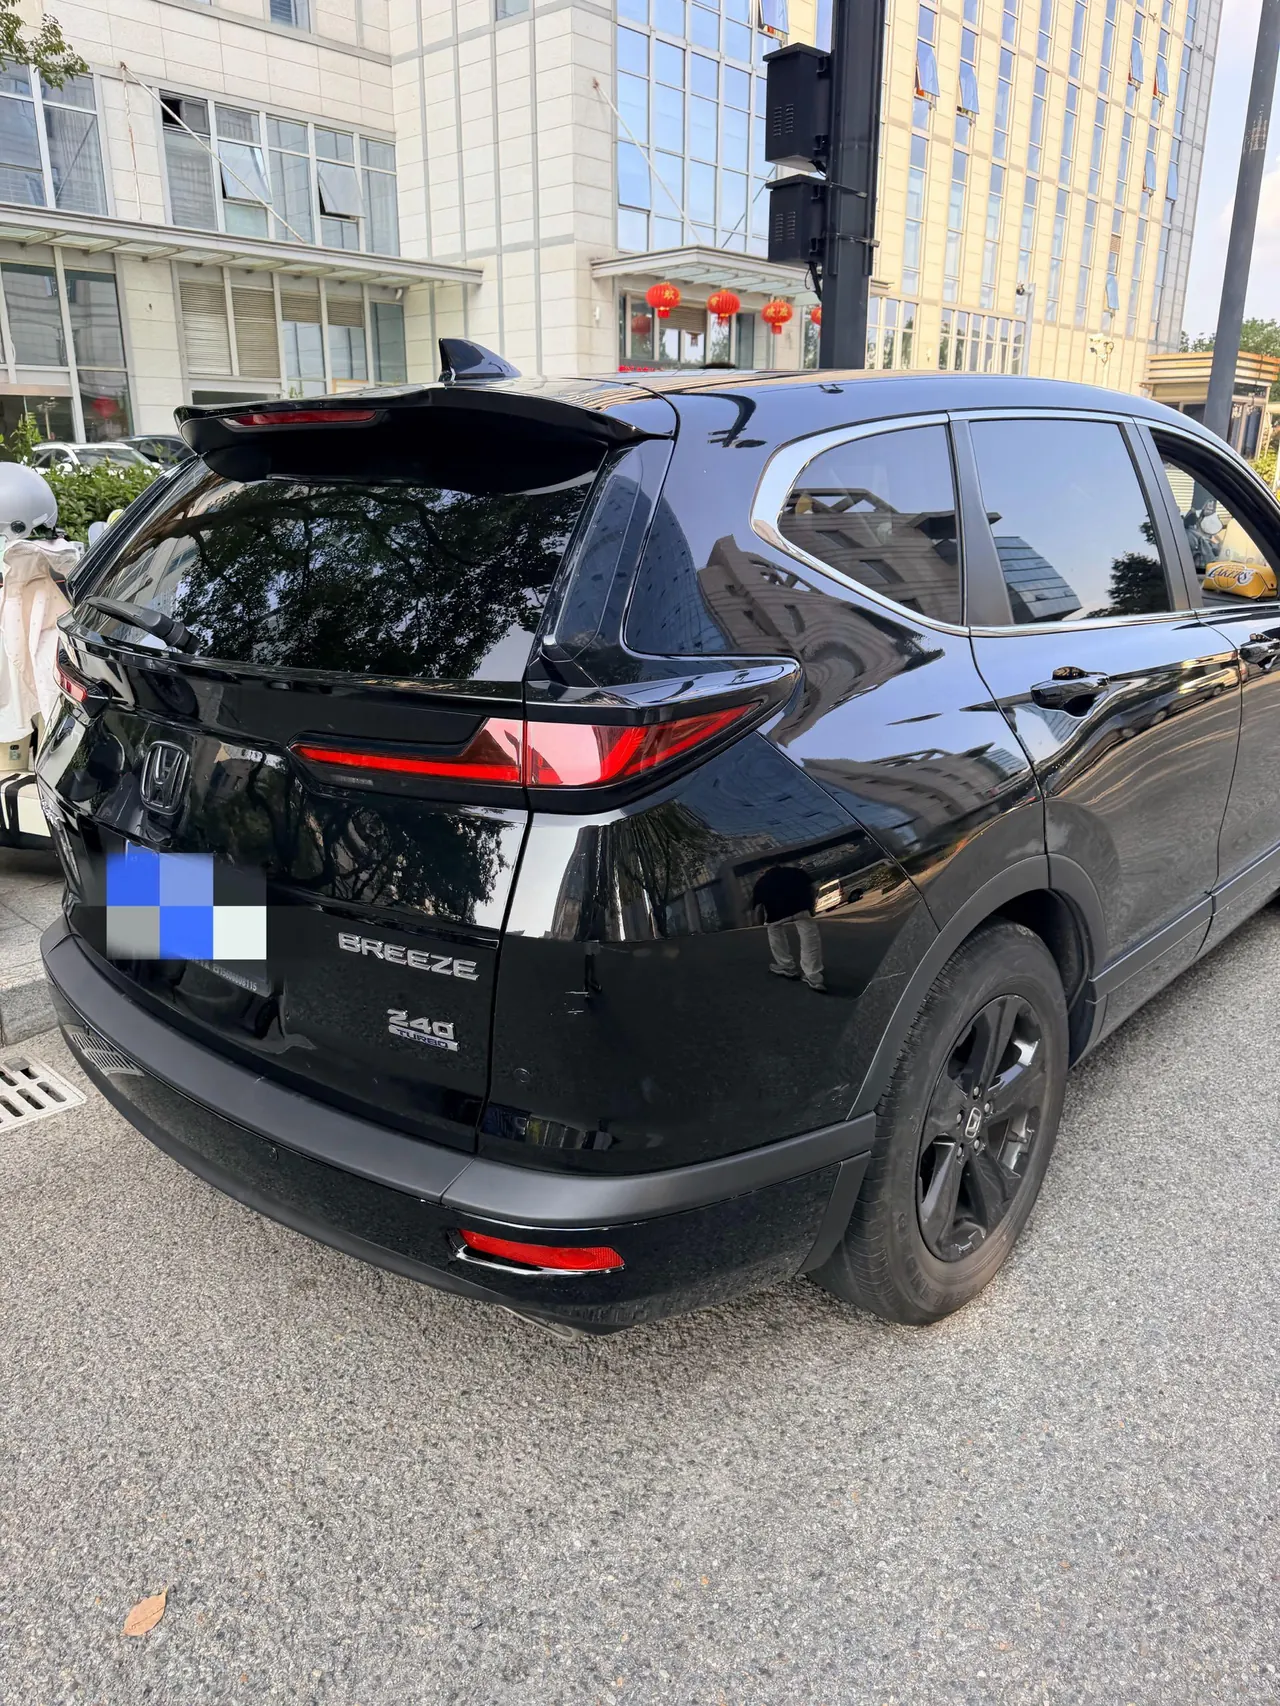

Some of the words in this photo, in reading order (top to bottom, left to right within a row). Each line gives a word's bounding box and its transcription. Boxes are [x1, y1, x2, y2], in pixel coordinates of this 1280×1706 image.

[338, 932, 480, 981] BREEZE
[387, 1008, 455, 1040] 240
[395, 1028, 449, 1049] TURBO
